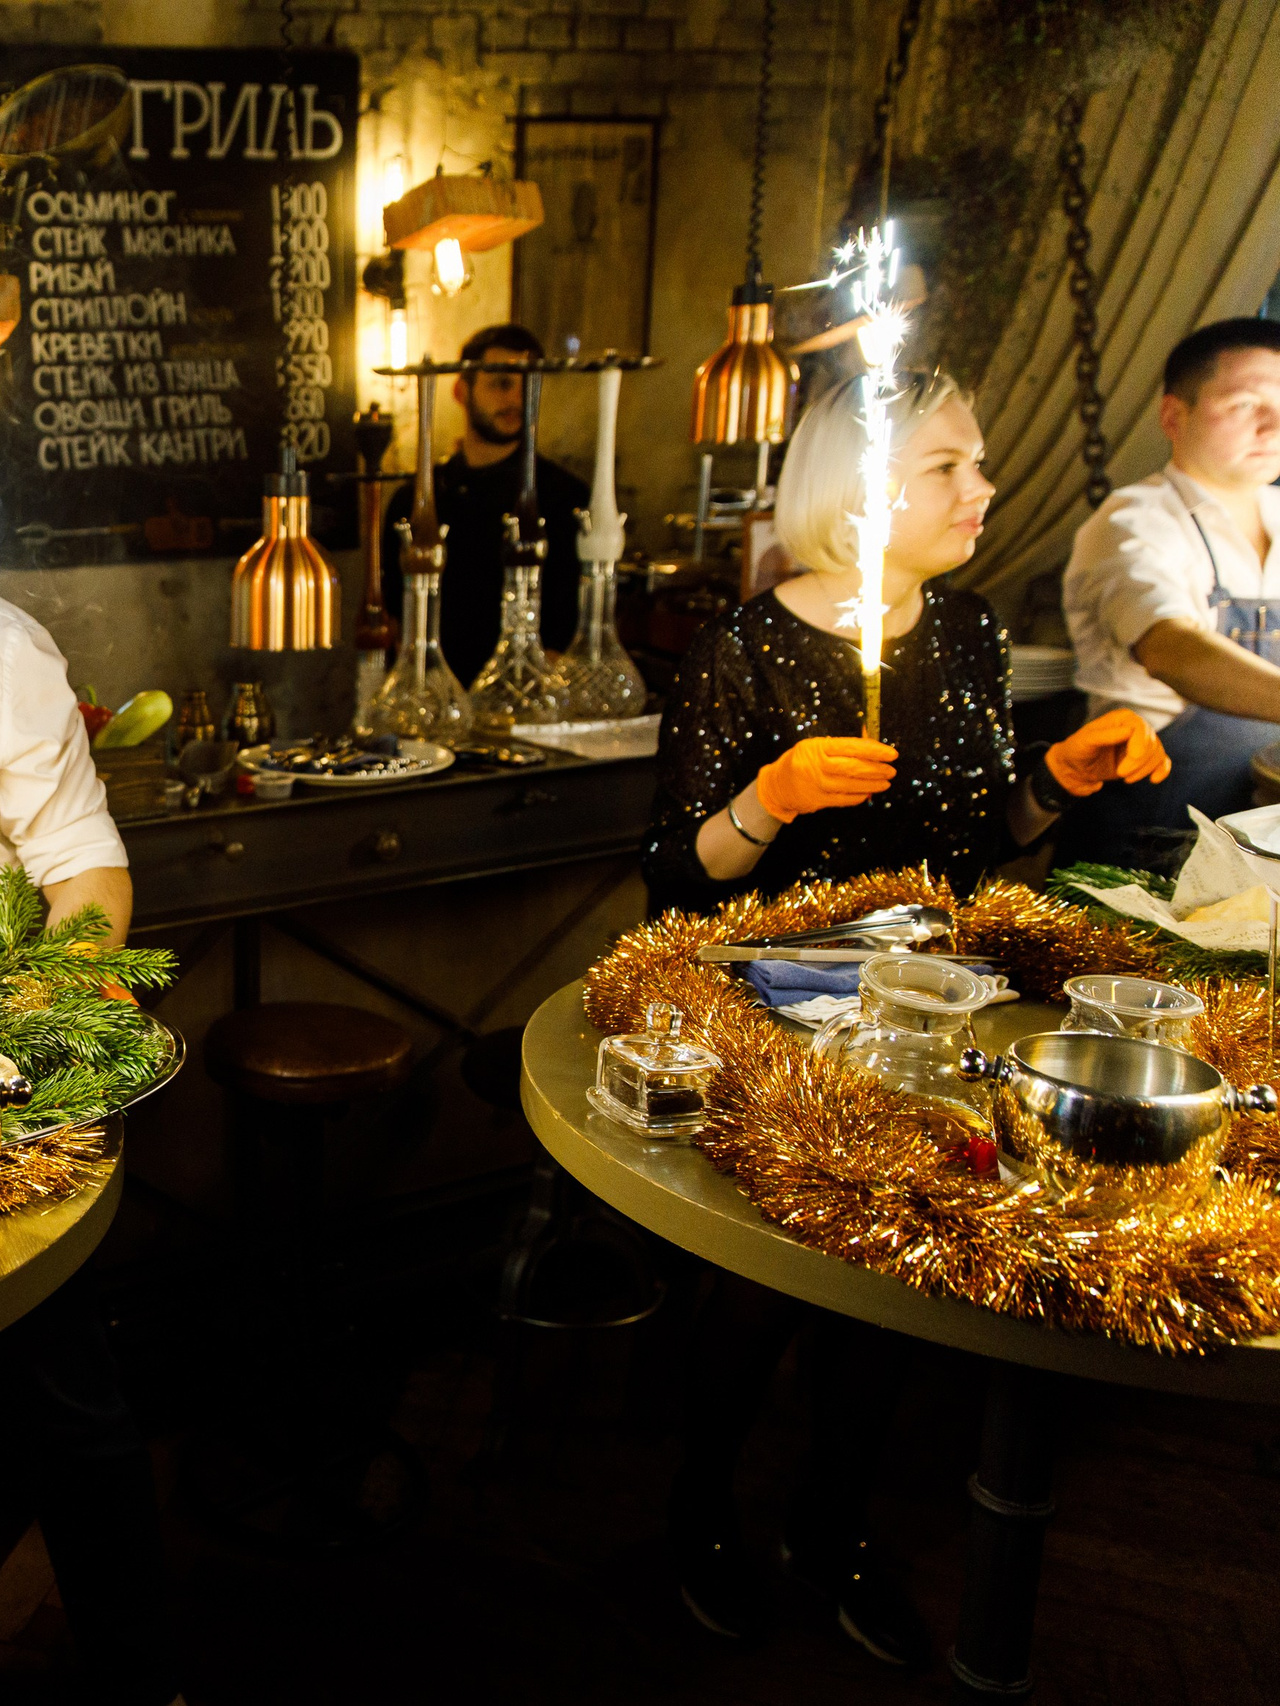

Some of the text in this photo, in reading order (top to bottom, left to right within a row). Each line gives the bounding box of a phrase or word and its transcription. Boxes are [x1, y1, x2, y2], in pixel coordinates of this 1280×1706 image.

[127, 79, 344, 160] ГРИЛЬ
[26, 189, 177, 223] ОСЬМИНОГ
[32, 222, 108, 259] СТЕЙК
[122, 224, 237, 258] МЯСНИКА
[29, 258, 116, 294] РИБАЙ
[29, 289, 187, 329] СТРИПЛОЙН
[31, 330, 162, 363] КРЕВЕТКИ
[32, 362, 117, 397] СТЕЙК
[123, 362, 160, 395] ИЗ
[162, 360, 241, 391] ТУНЦА
[33, 398, 146, 434] ОВОЩИ
[153, 394, 233, 428] ГРИЛЬ
[38, 430, 131, 470] СТЕЙК
[139, 427, 248, 466] КАНТРИ
